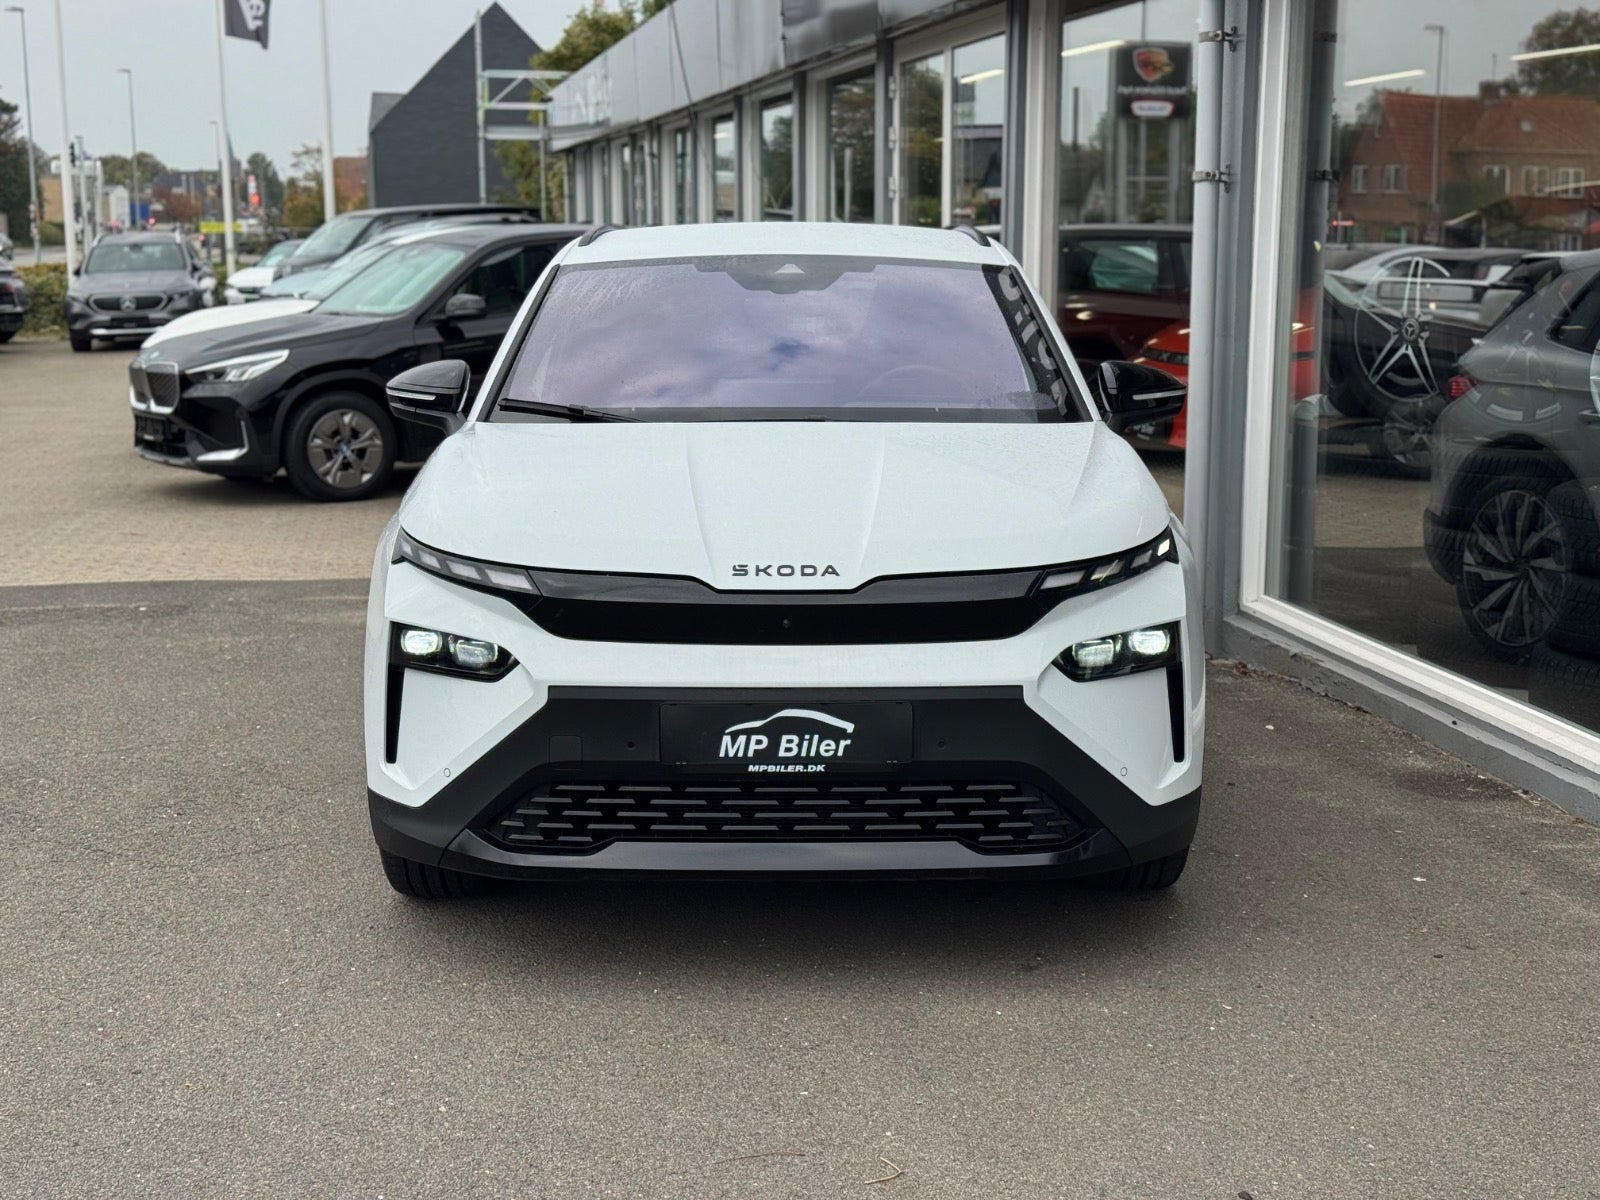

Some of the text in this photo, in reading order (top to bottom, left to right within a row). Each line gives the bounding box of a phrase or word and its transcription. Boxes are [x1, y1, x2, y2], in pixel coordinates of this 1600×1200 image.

[719, 734, 851, 758] MP Biler
[748, 764, 826, 773] MPBILER.DK
